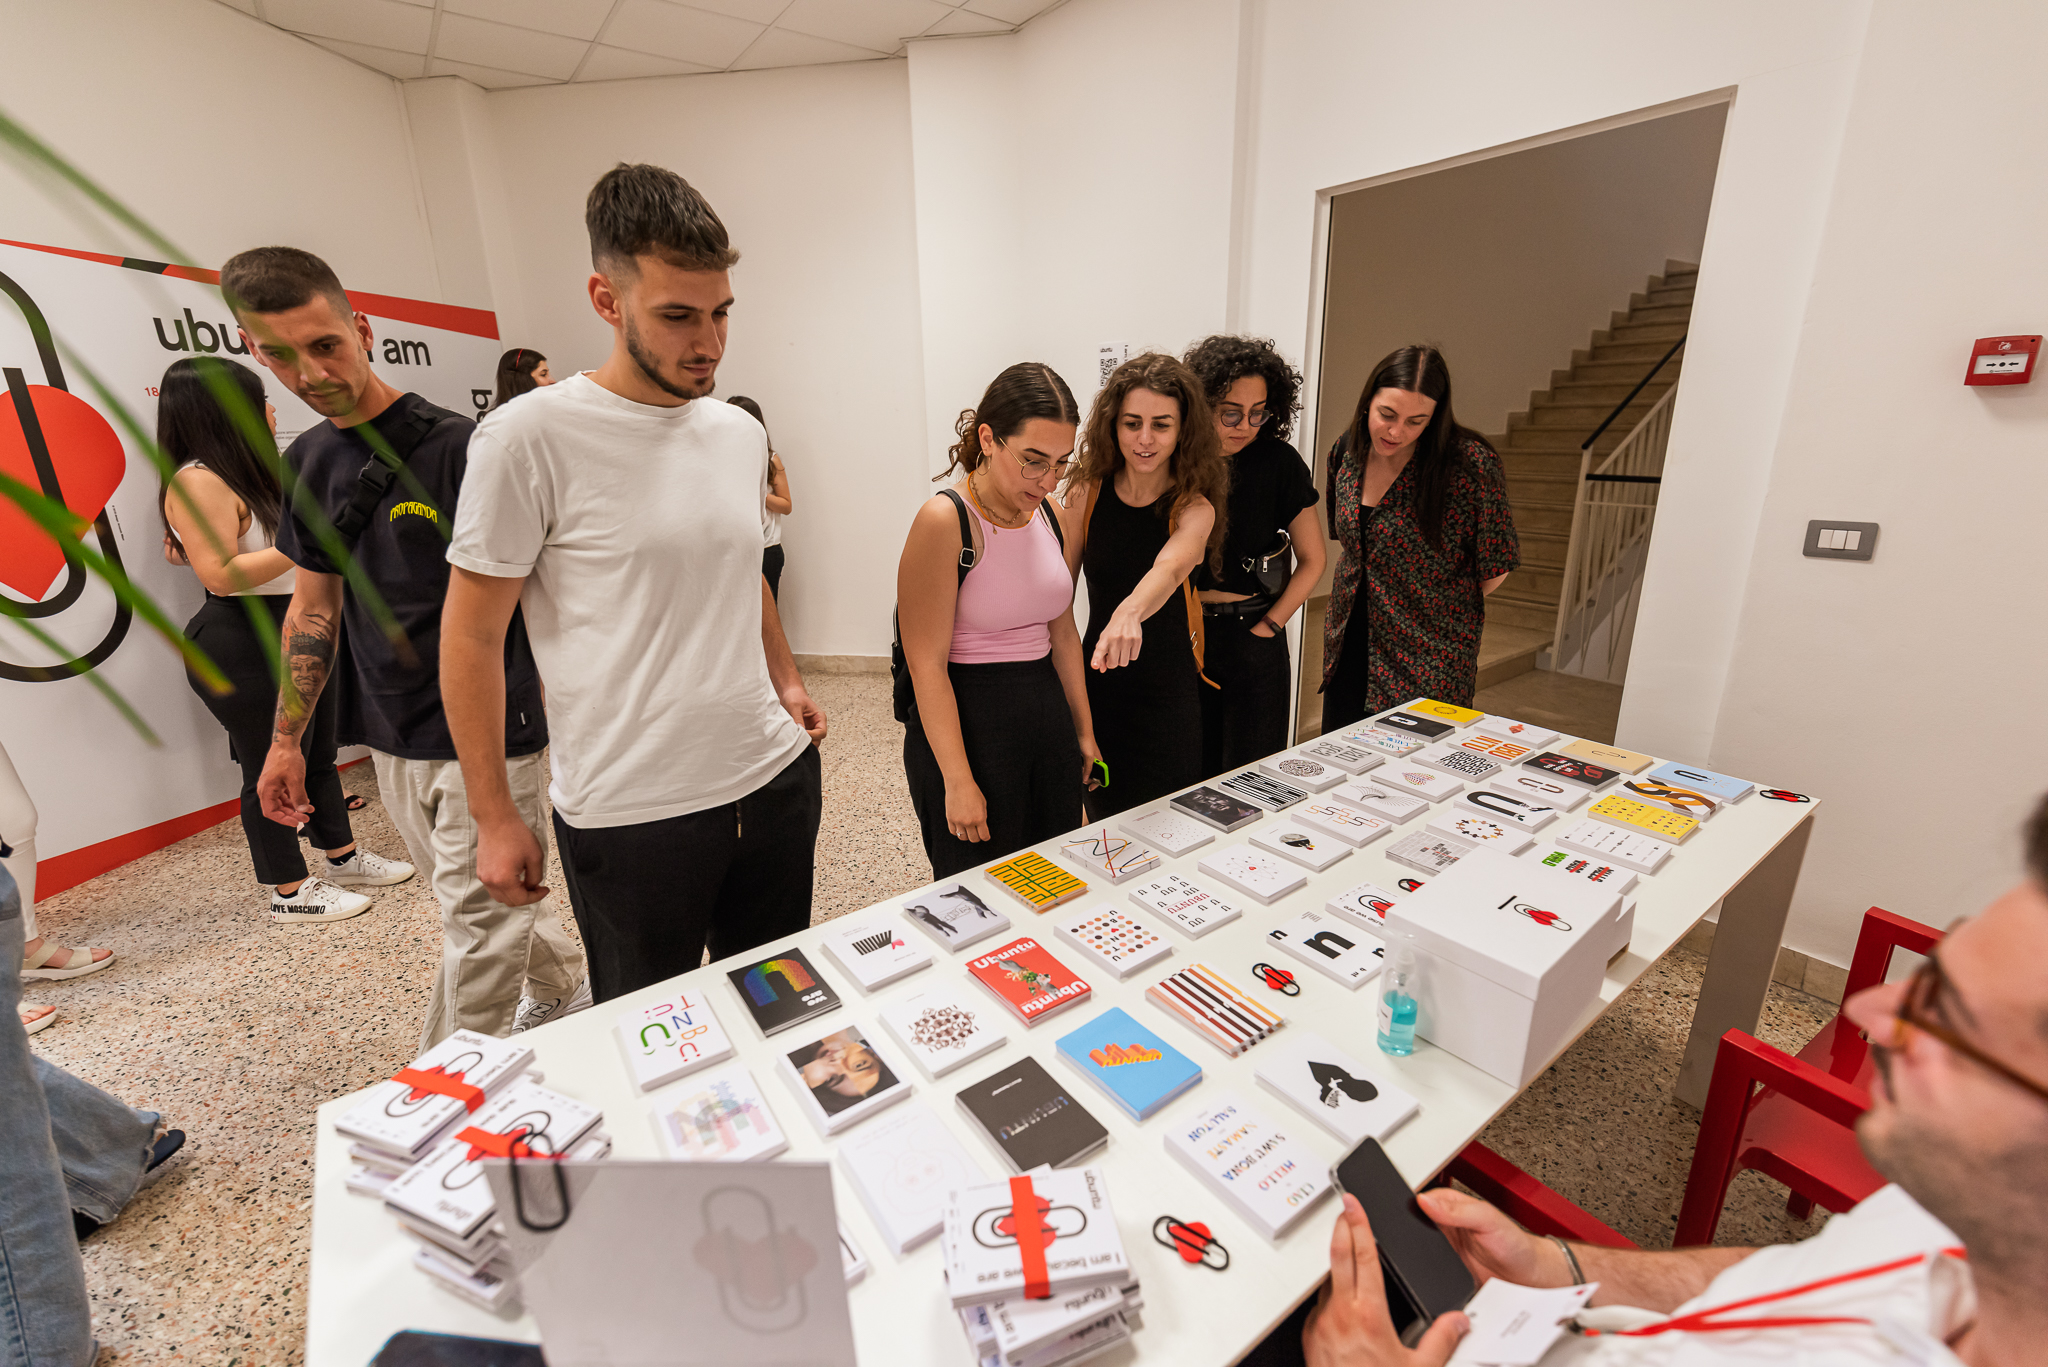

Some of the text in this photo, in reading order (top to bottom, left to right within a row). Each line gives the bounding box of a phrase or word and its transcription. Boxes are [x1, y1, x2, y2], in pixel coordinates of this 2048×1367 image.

[152, 307, 432, 366] ubu am
[390, 501, 438, 523] PROPAGANDA
[287, 904, 326, 915] MOSCHINO
[1165, 892, 1210, 914] UBUNTU
[973, 940, 1036, 969] Ubuntu
[1021, 980, 1088, 1014] Ubuntu
[1187, 1105, 1237, 1142] SALUTON
[1258, 1159, 1296, 1191] HELLO
[1286, 1182, 1315, 1207] CIAO
